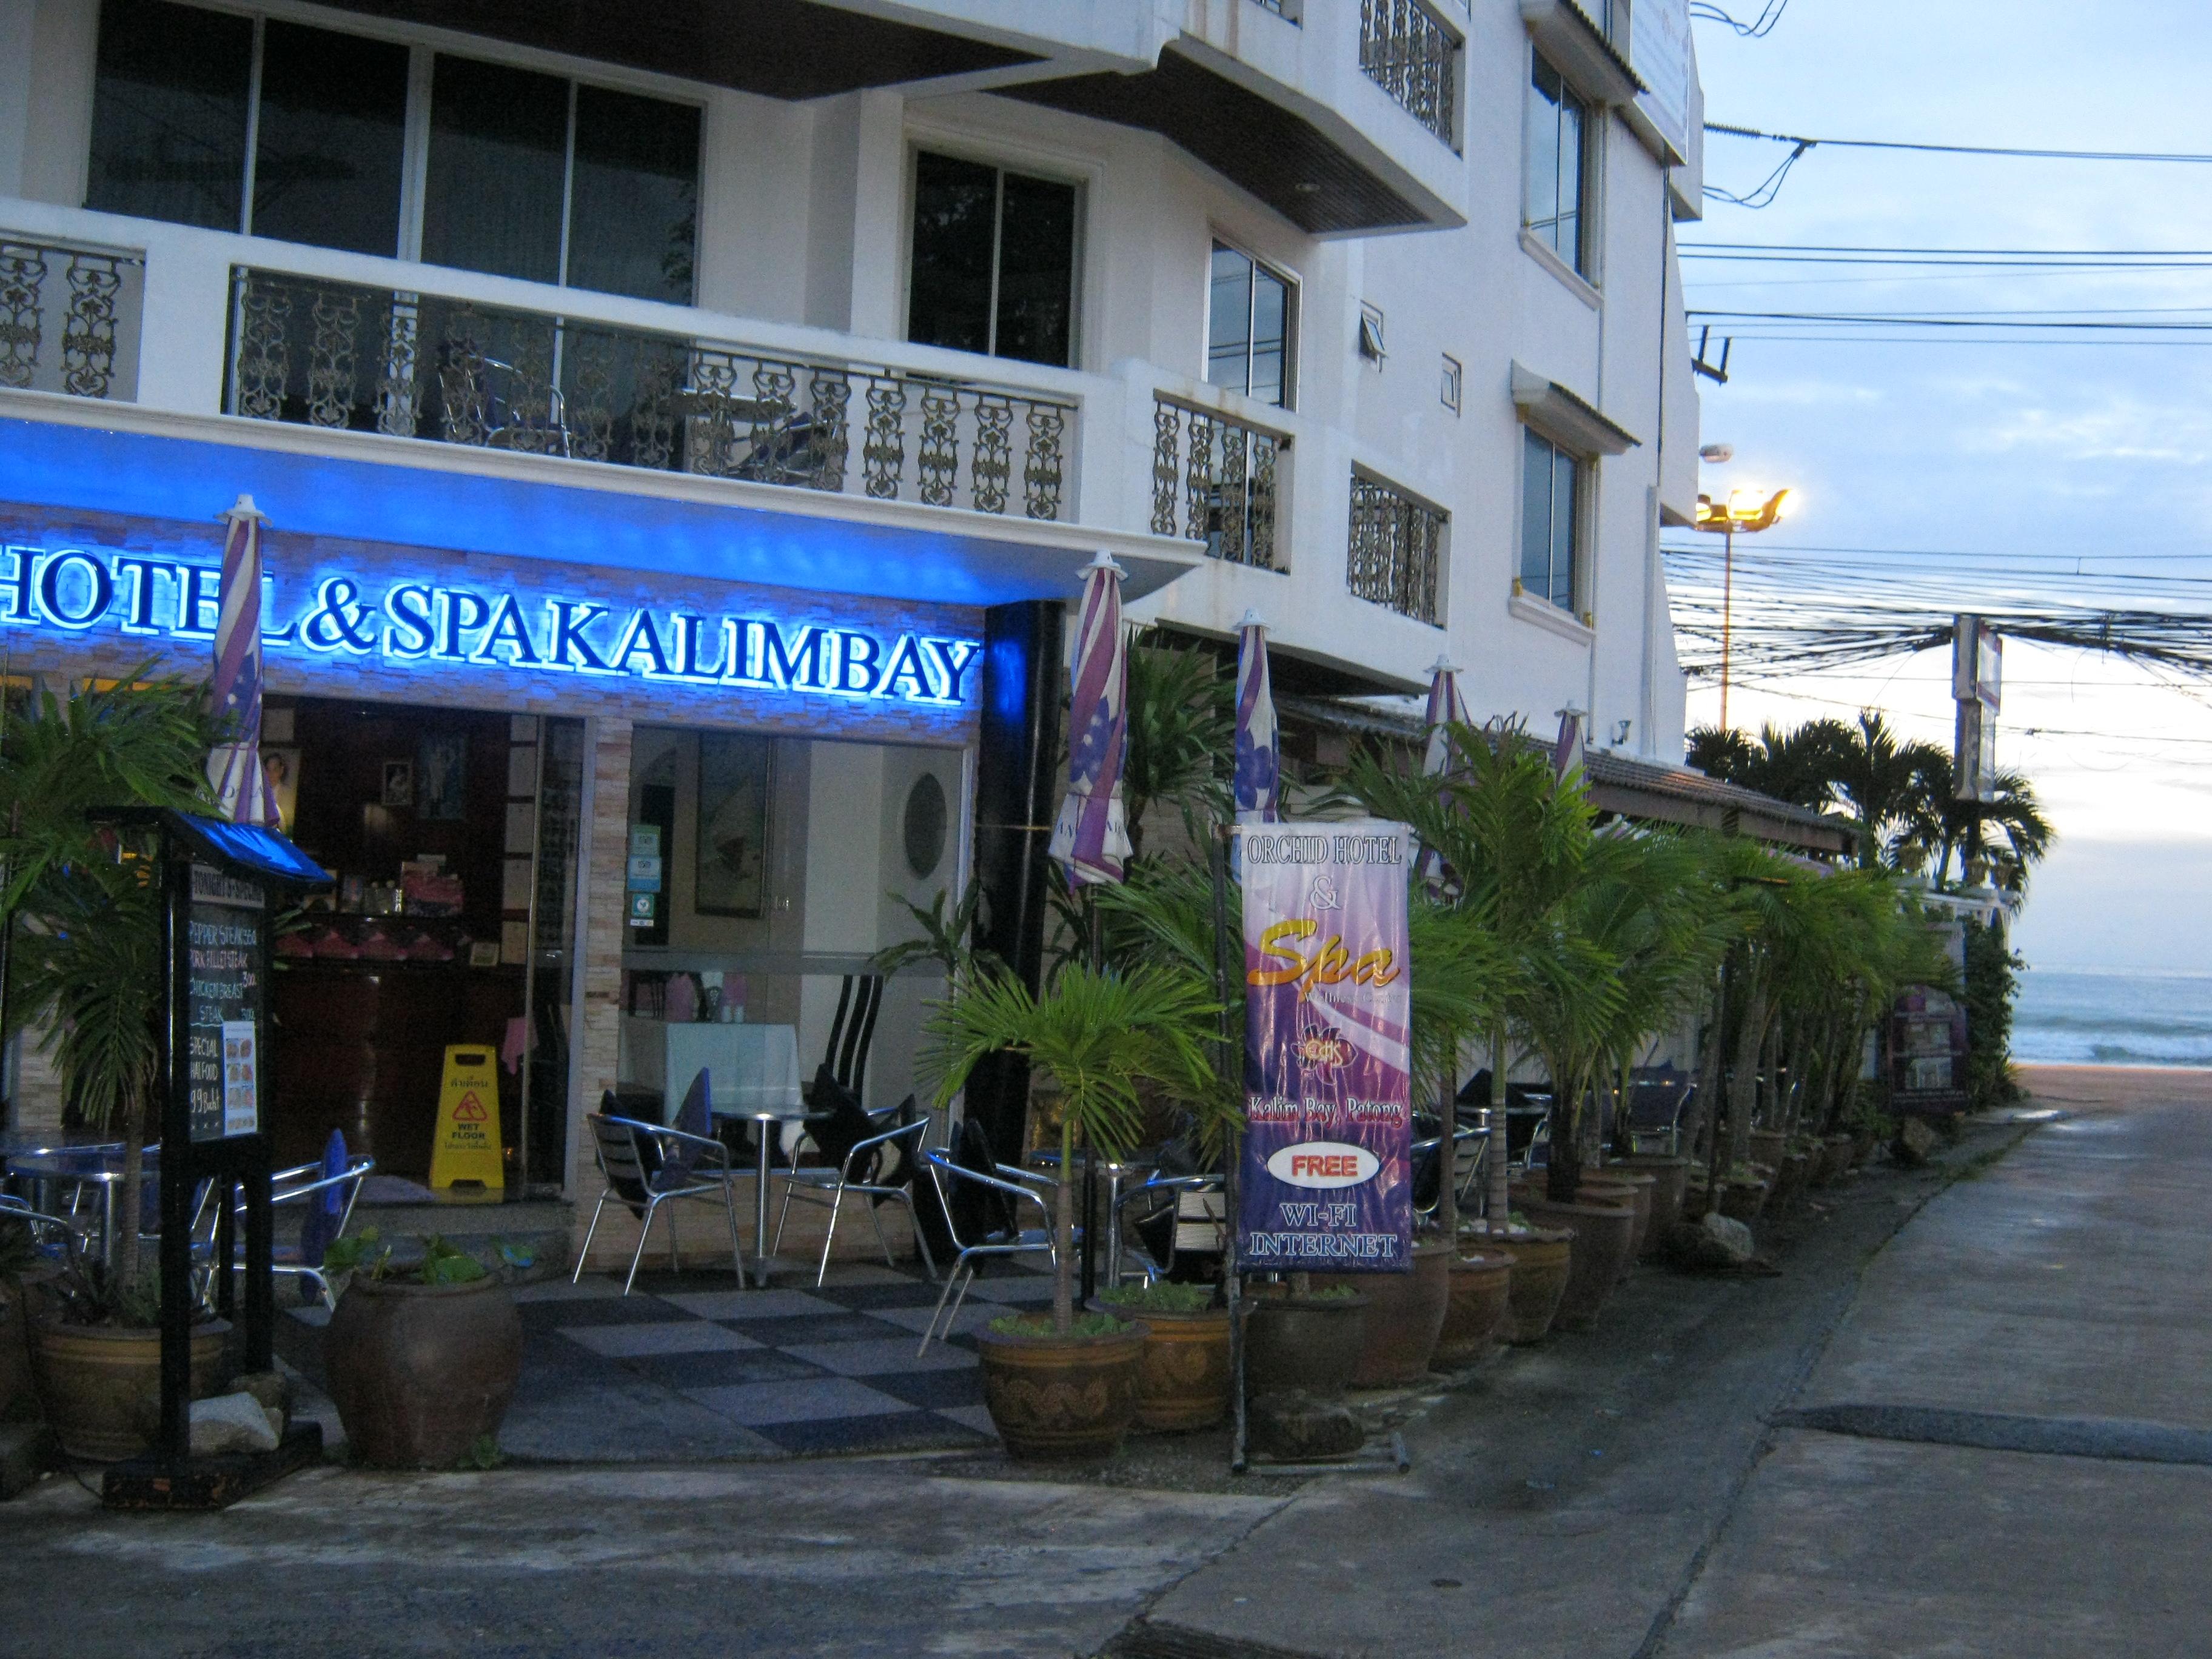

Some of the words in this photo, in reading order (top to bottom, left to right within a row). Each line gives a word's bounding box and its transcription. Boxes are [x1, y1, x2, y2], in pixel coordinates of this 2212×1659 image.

[301, 576, 380, 655] &
[1247, 834, 1329, 865] ORCHID
[1333, 836, 1402, 865] HOTEL
[1310, 876, 1342, 910] &
[1247, 919, 1400, 1004] Spa
[199, 1005, 223, 1022] STEAK
[1250, 1096, 1299, 1121] Kalim
[1304, 1096, 1342, 1128] Bay,
[1347, 1097, 1404, 1128] Patong
[1292, 1155, 1359, 1177] FREE
[1280, 1203, 1357, 1227] WI-FI
[1249, 1232, 1398, 1257] INTERNET
